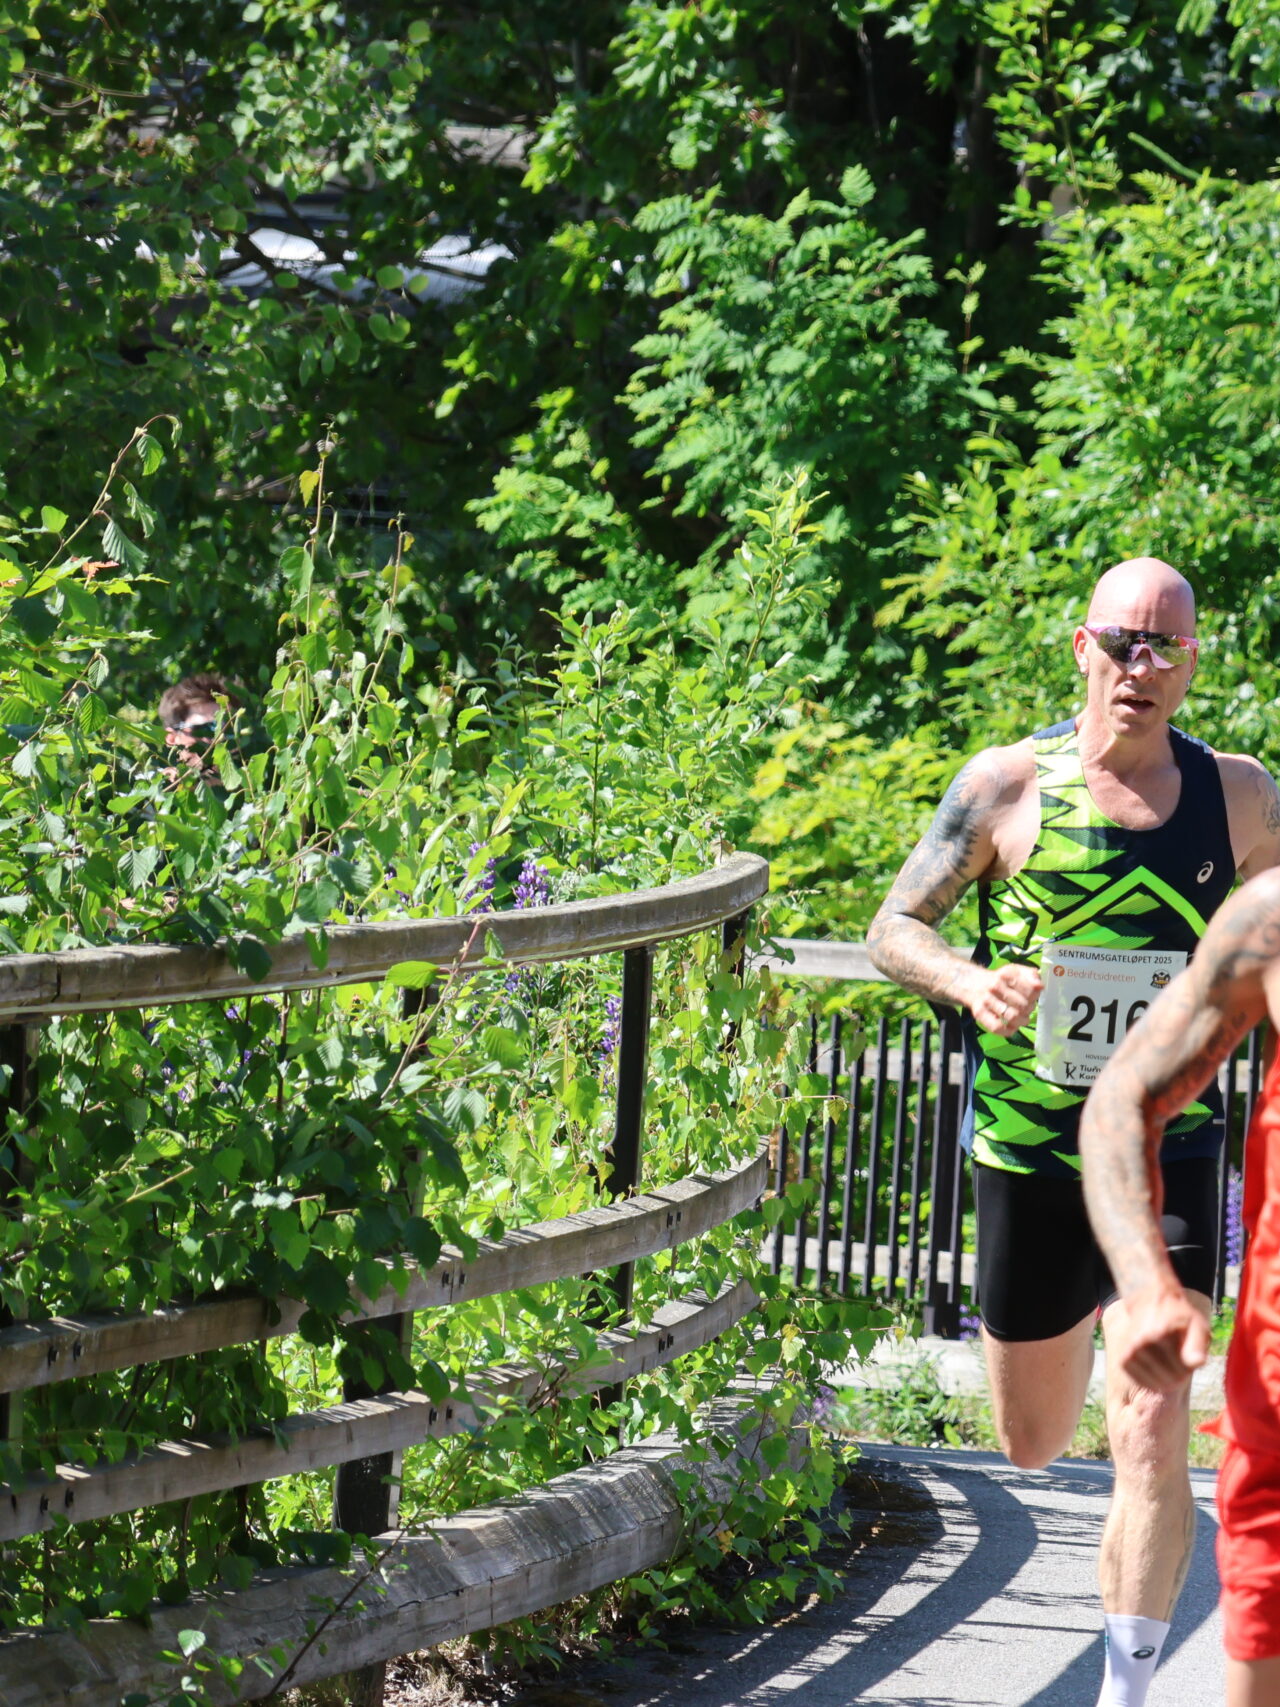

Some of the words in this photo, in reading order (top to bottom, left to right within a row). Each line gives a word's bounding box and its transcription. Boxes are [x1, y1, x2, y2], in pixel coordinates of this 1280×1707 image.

[1058, 949, 1152, 964] SENTRUMSGATELØPET
[1154, 956, 1173, 964] 2025
[1067, 969, 1136, 983] Bedriftsidretten
